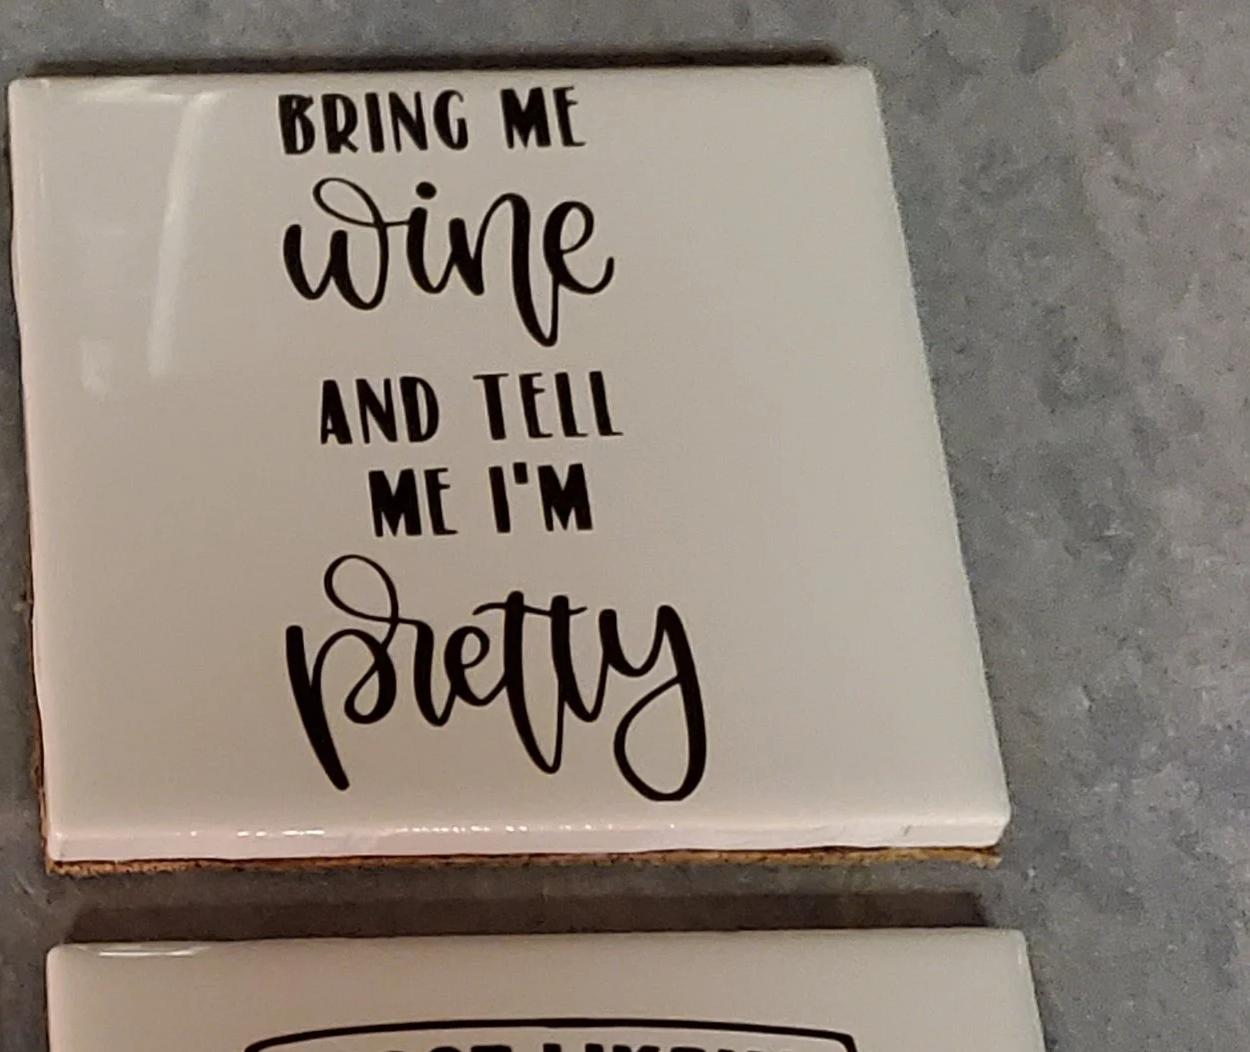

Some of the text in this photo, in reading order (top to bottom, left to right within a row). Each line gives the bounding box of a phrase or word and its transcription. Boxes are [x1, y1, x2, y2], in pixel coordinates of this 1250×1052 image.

[278, 86, 586, 155] BRING ME
[283, 177, 615, 348] wine
[320, 370, 624, 446] AND TELL
[368, 461, 593, 538] ME I'M
[285, 554, 707, 802] pretty
